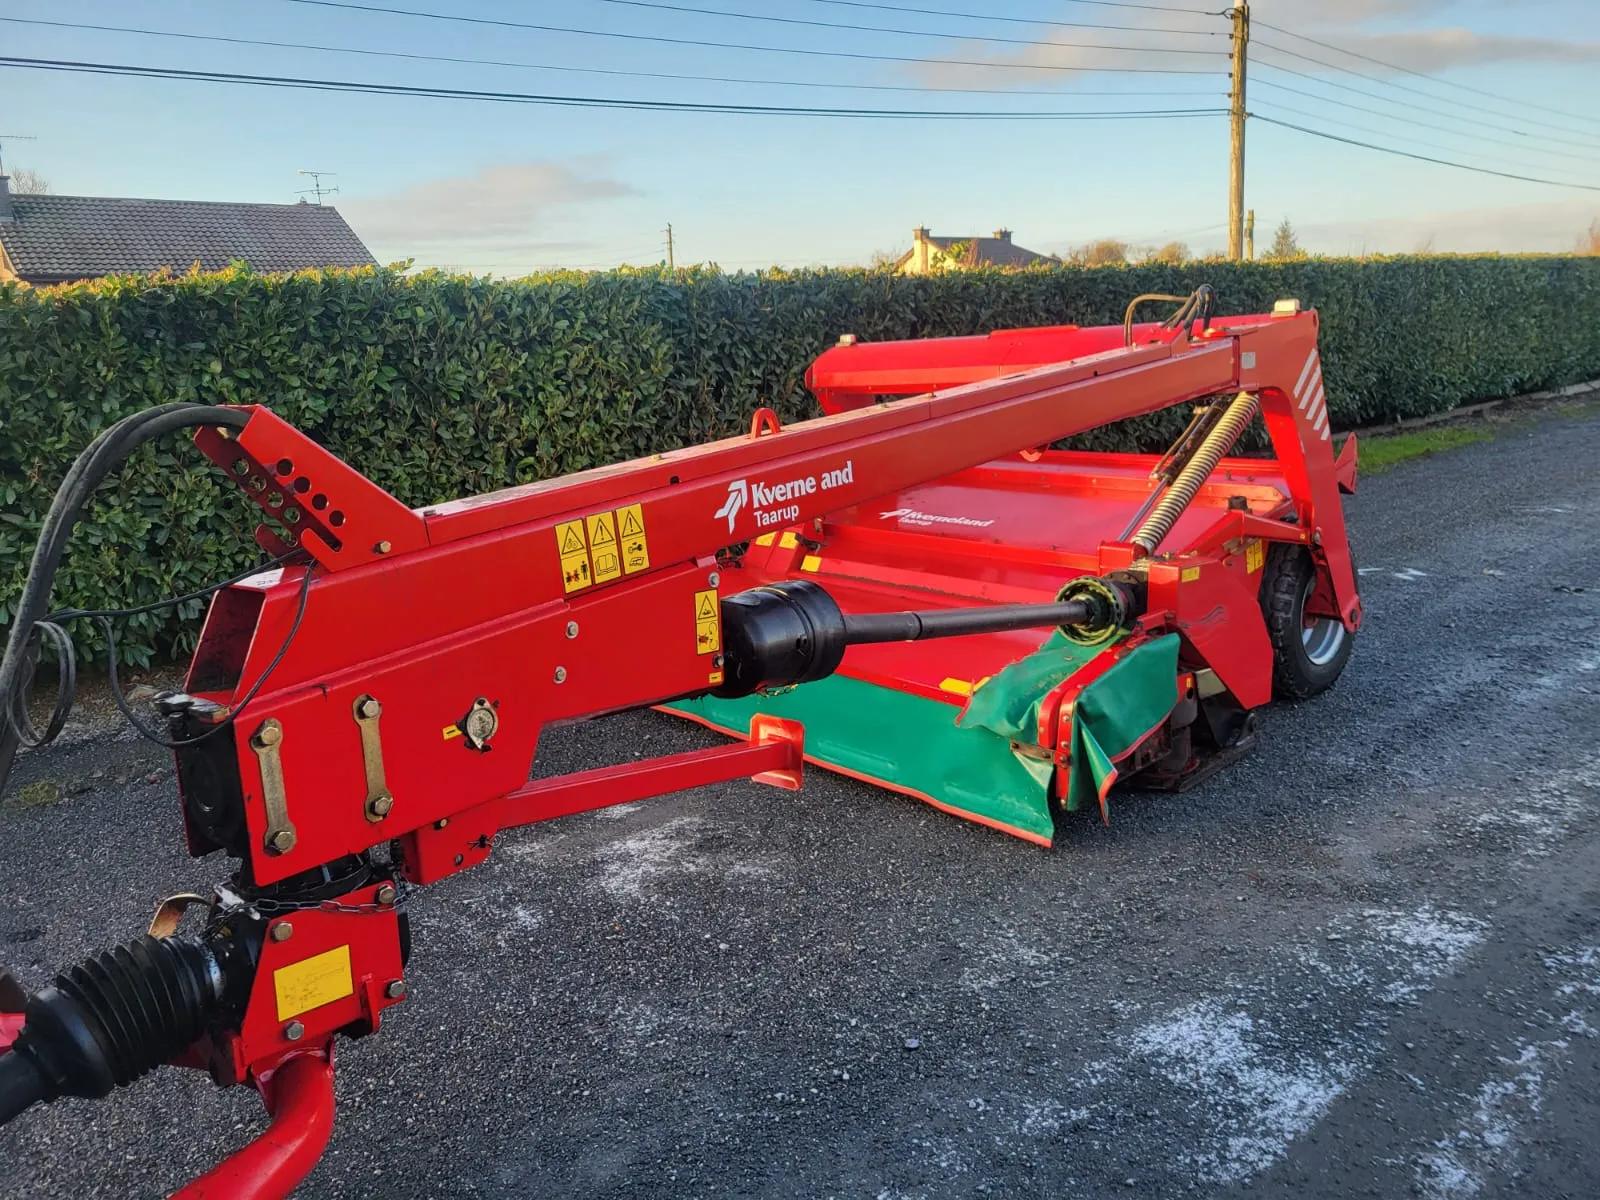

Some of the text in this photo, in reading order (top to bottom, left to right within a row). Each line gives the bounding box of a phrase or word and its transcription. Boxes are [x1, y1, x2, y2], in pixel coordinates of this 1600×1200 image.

[751, 460, 853, 508] Kverne and
[754, 504, 799, 527] Taarup
